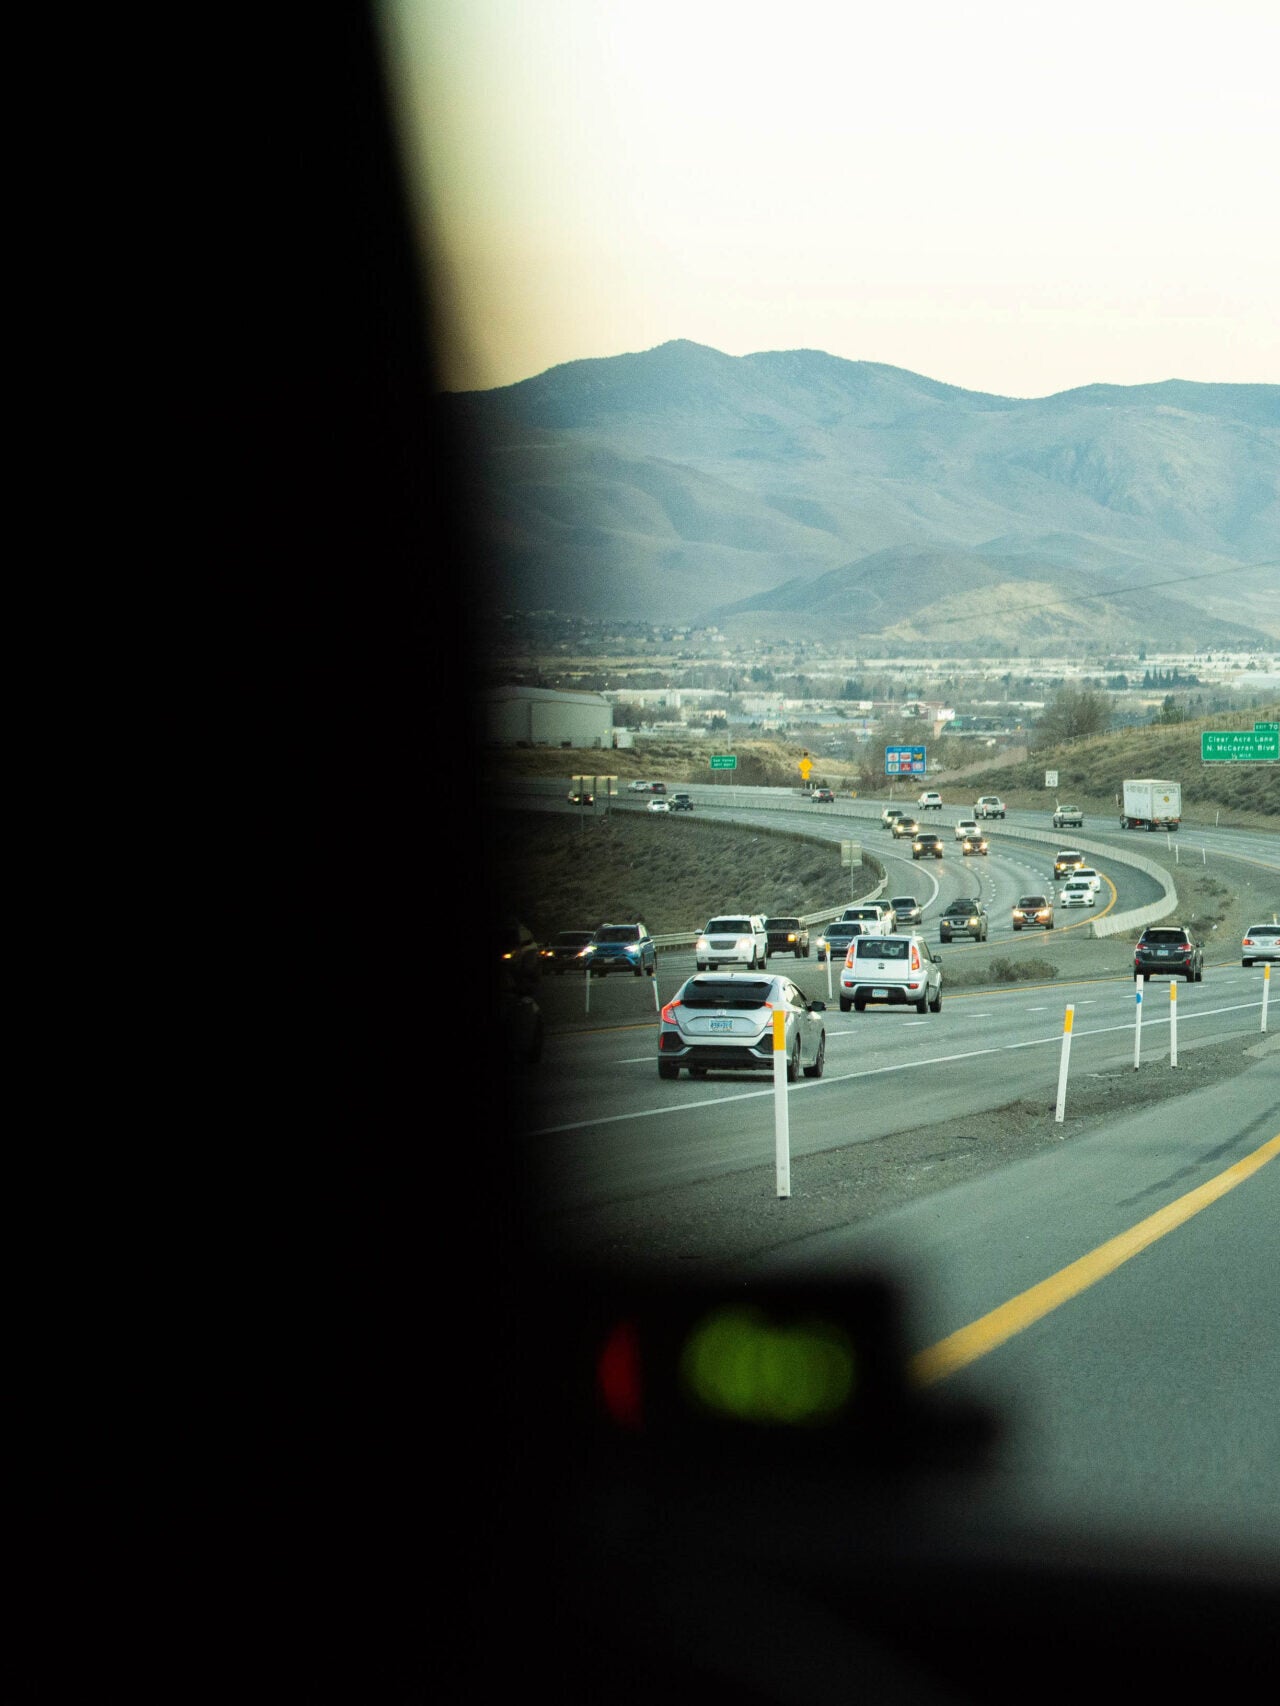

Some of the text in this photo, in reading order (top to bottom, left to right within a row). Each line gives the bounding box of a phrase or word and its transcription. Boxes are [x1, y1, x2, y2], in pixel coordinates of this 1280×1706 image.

[1208, 735, 1274, 743] Clear Acre Lane
[1216, 744, 1254, 752] McCarran
[1257, 744, 1276, 752] Blvd
